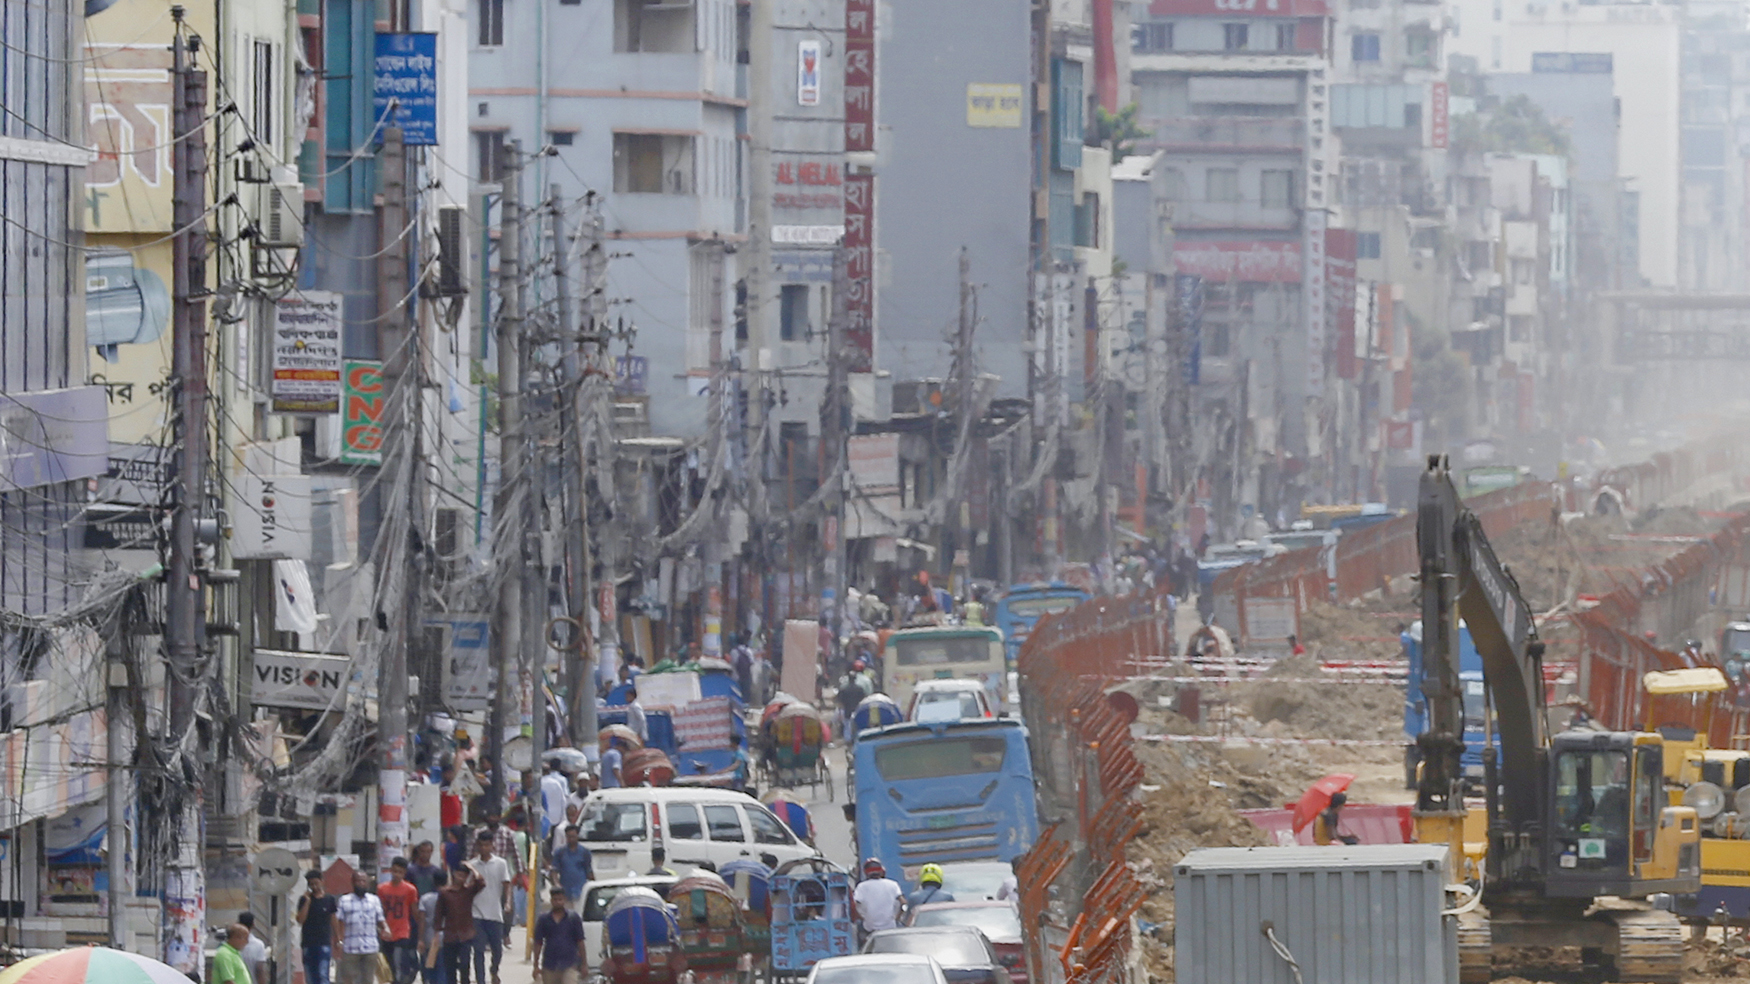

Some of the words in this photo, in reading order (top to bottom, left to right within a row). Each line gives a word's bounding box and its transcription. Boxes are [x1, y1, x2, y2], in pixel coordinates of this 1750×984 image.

[346, 366, 384, 451] CNG
[261, 480, 275, 548] VISION
[255, 663, 340, 690] VISION
